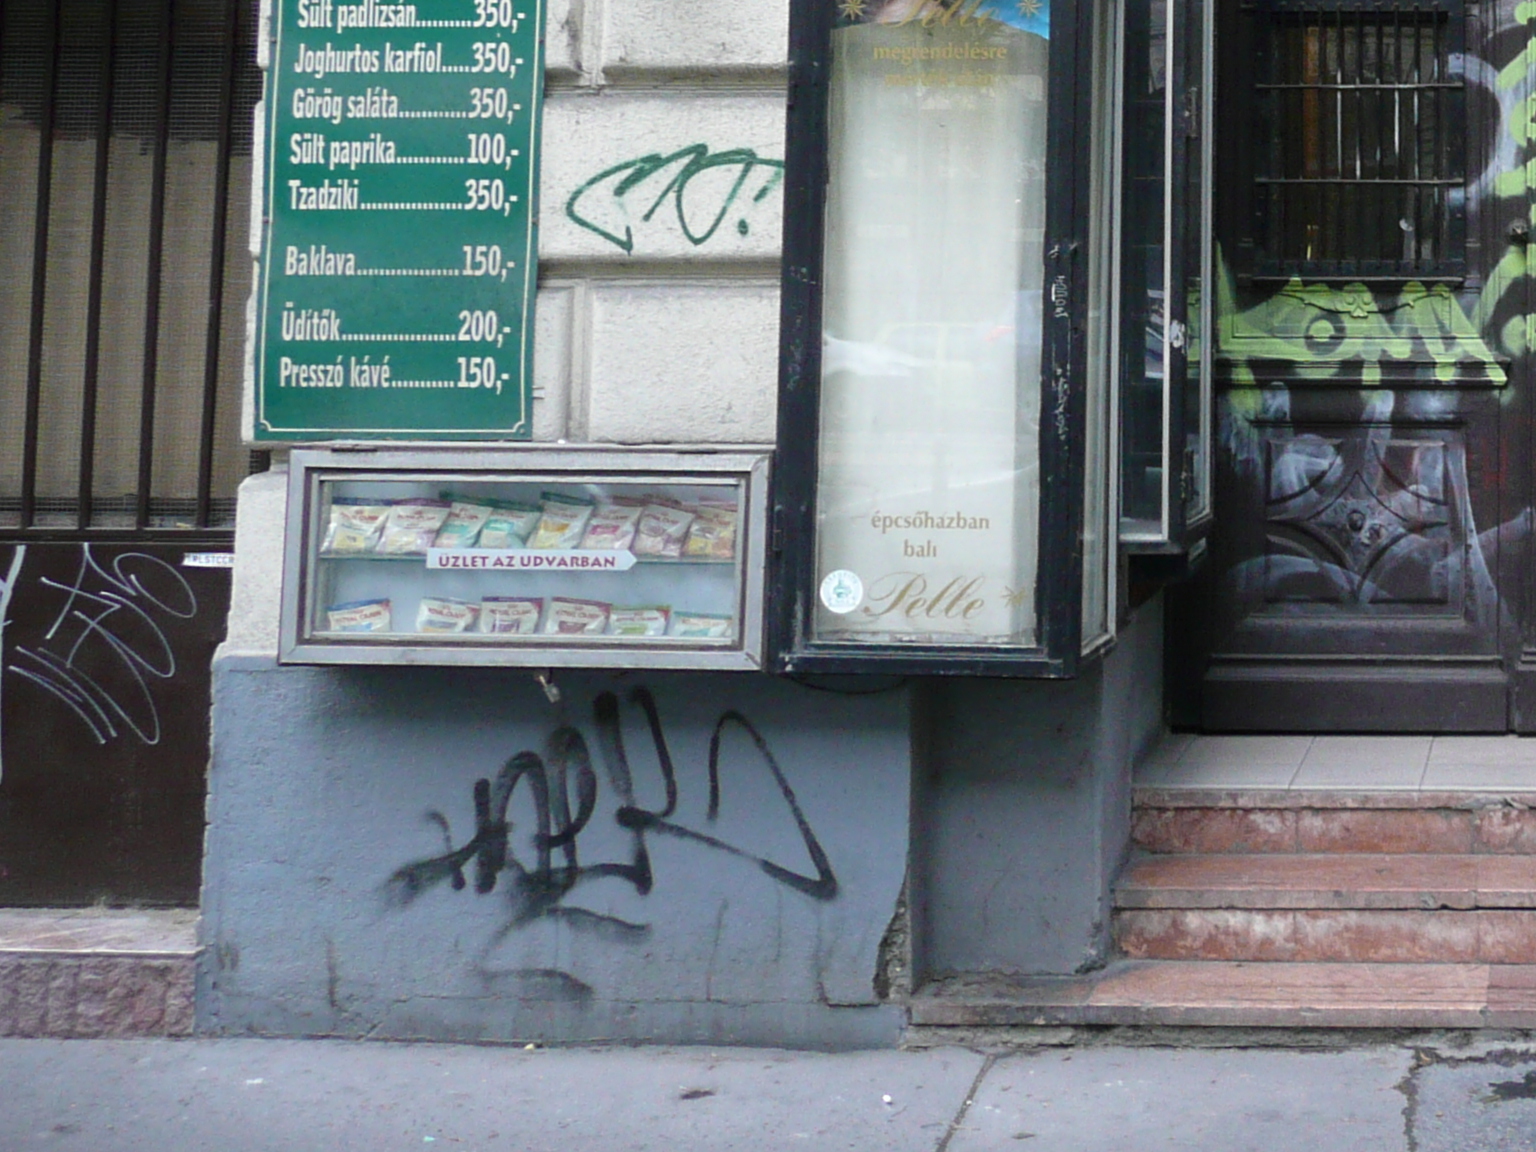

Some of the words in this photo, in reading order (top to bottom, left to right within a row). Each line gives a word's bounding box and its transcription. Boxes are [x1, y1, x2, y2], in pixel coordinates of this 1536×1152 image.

[294, 42, 380, 78] Joghurtos
[873, 41, 1007, 66] megrendelésre
[292, 88, 343, 124] Görög
[289, 134, 325, 164] Sült
[279, 356, 343, 389] Presszó
[438, 552, 490, 569] ÜZLET
[492, 555, 517, 569] AZ
[519, 554, 617, 569] UDVARBAN
[862, 571, 987, 622] Pelle
